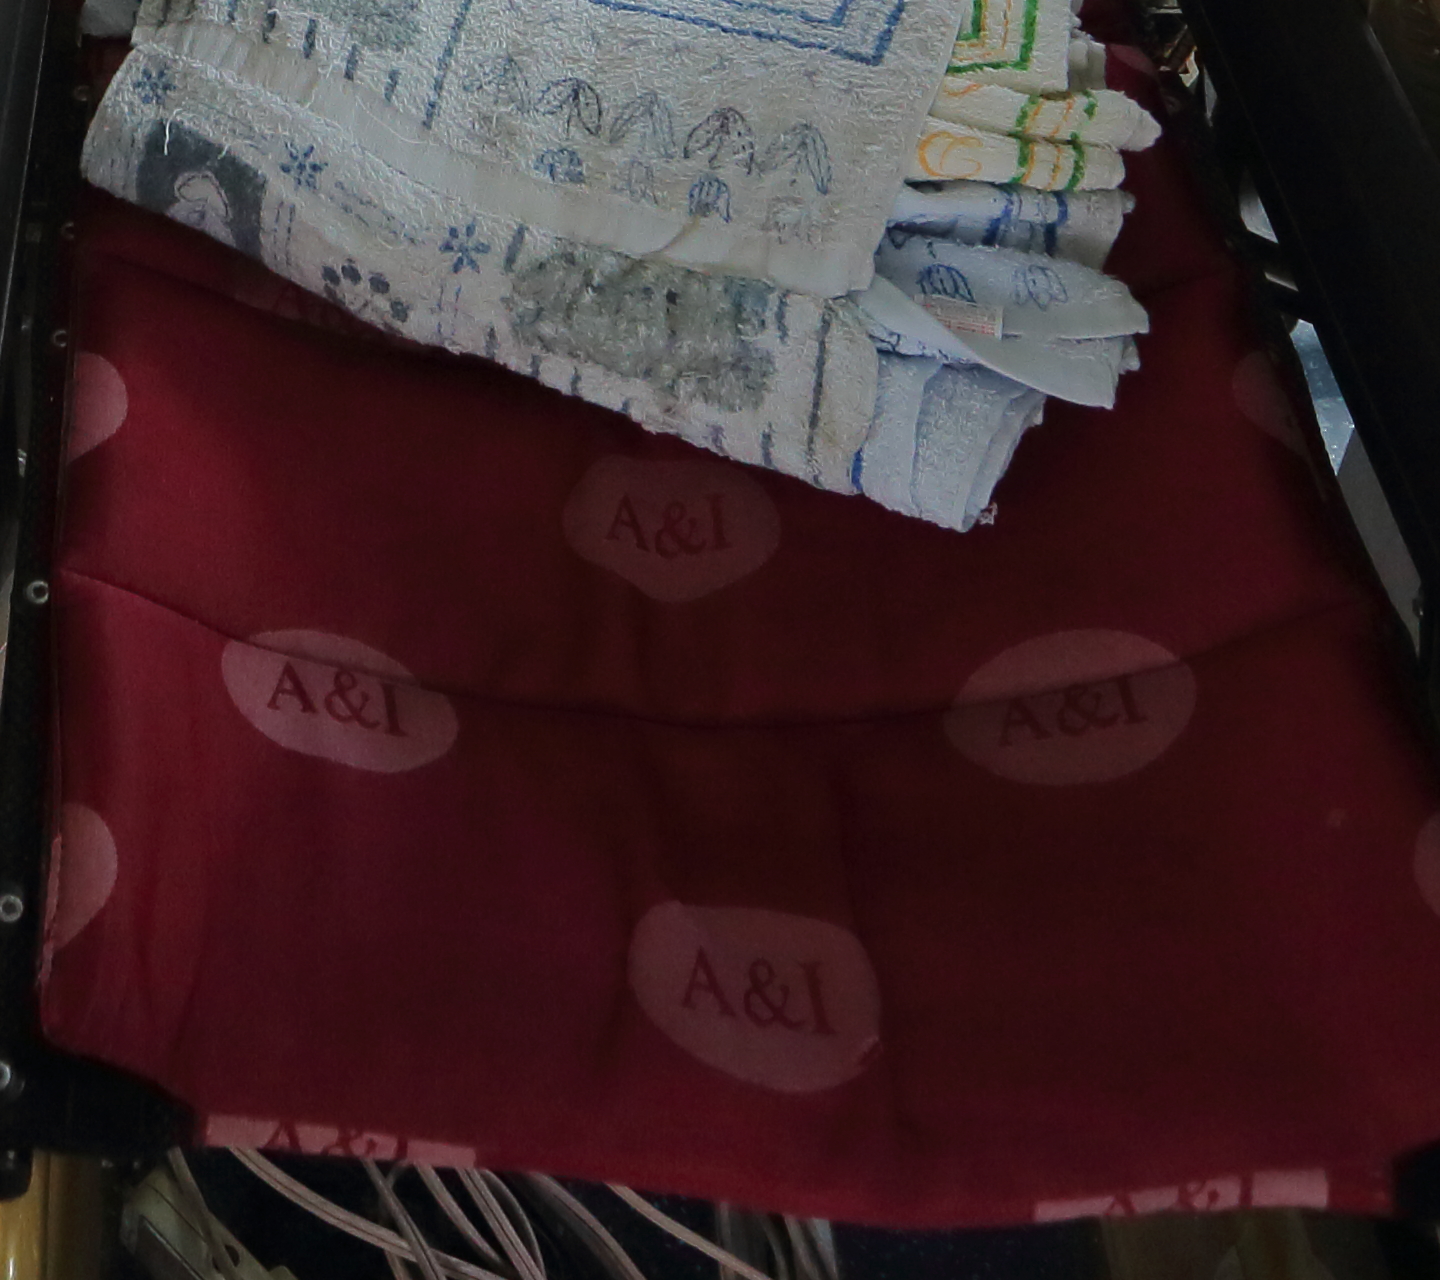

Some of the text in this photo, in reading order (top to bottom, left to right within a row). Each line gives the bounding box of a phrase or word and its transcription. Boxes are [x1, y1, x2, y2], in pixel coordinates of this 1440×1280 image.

[605, 492, 735, 560] A&I
[266, 659, 410, 738] A&I
[996, 673, 1150, 749] A&I
[681, 944, 839, 1037] A&I
